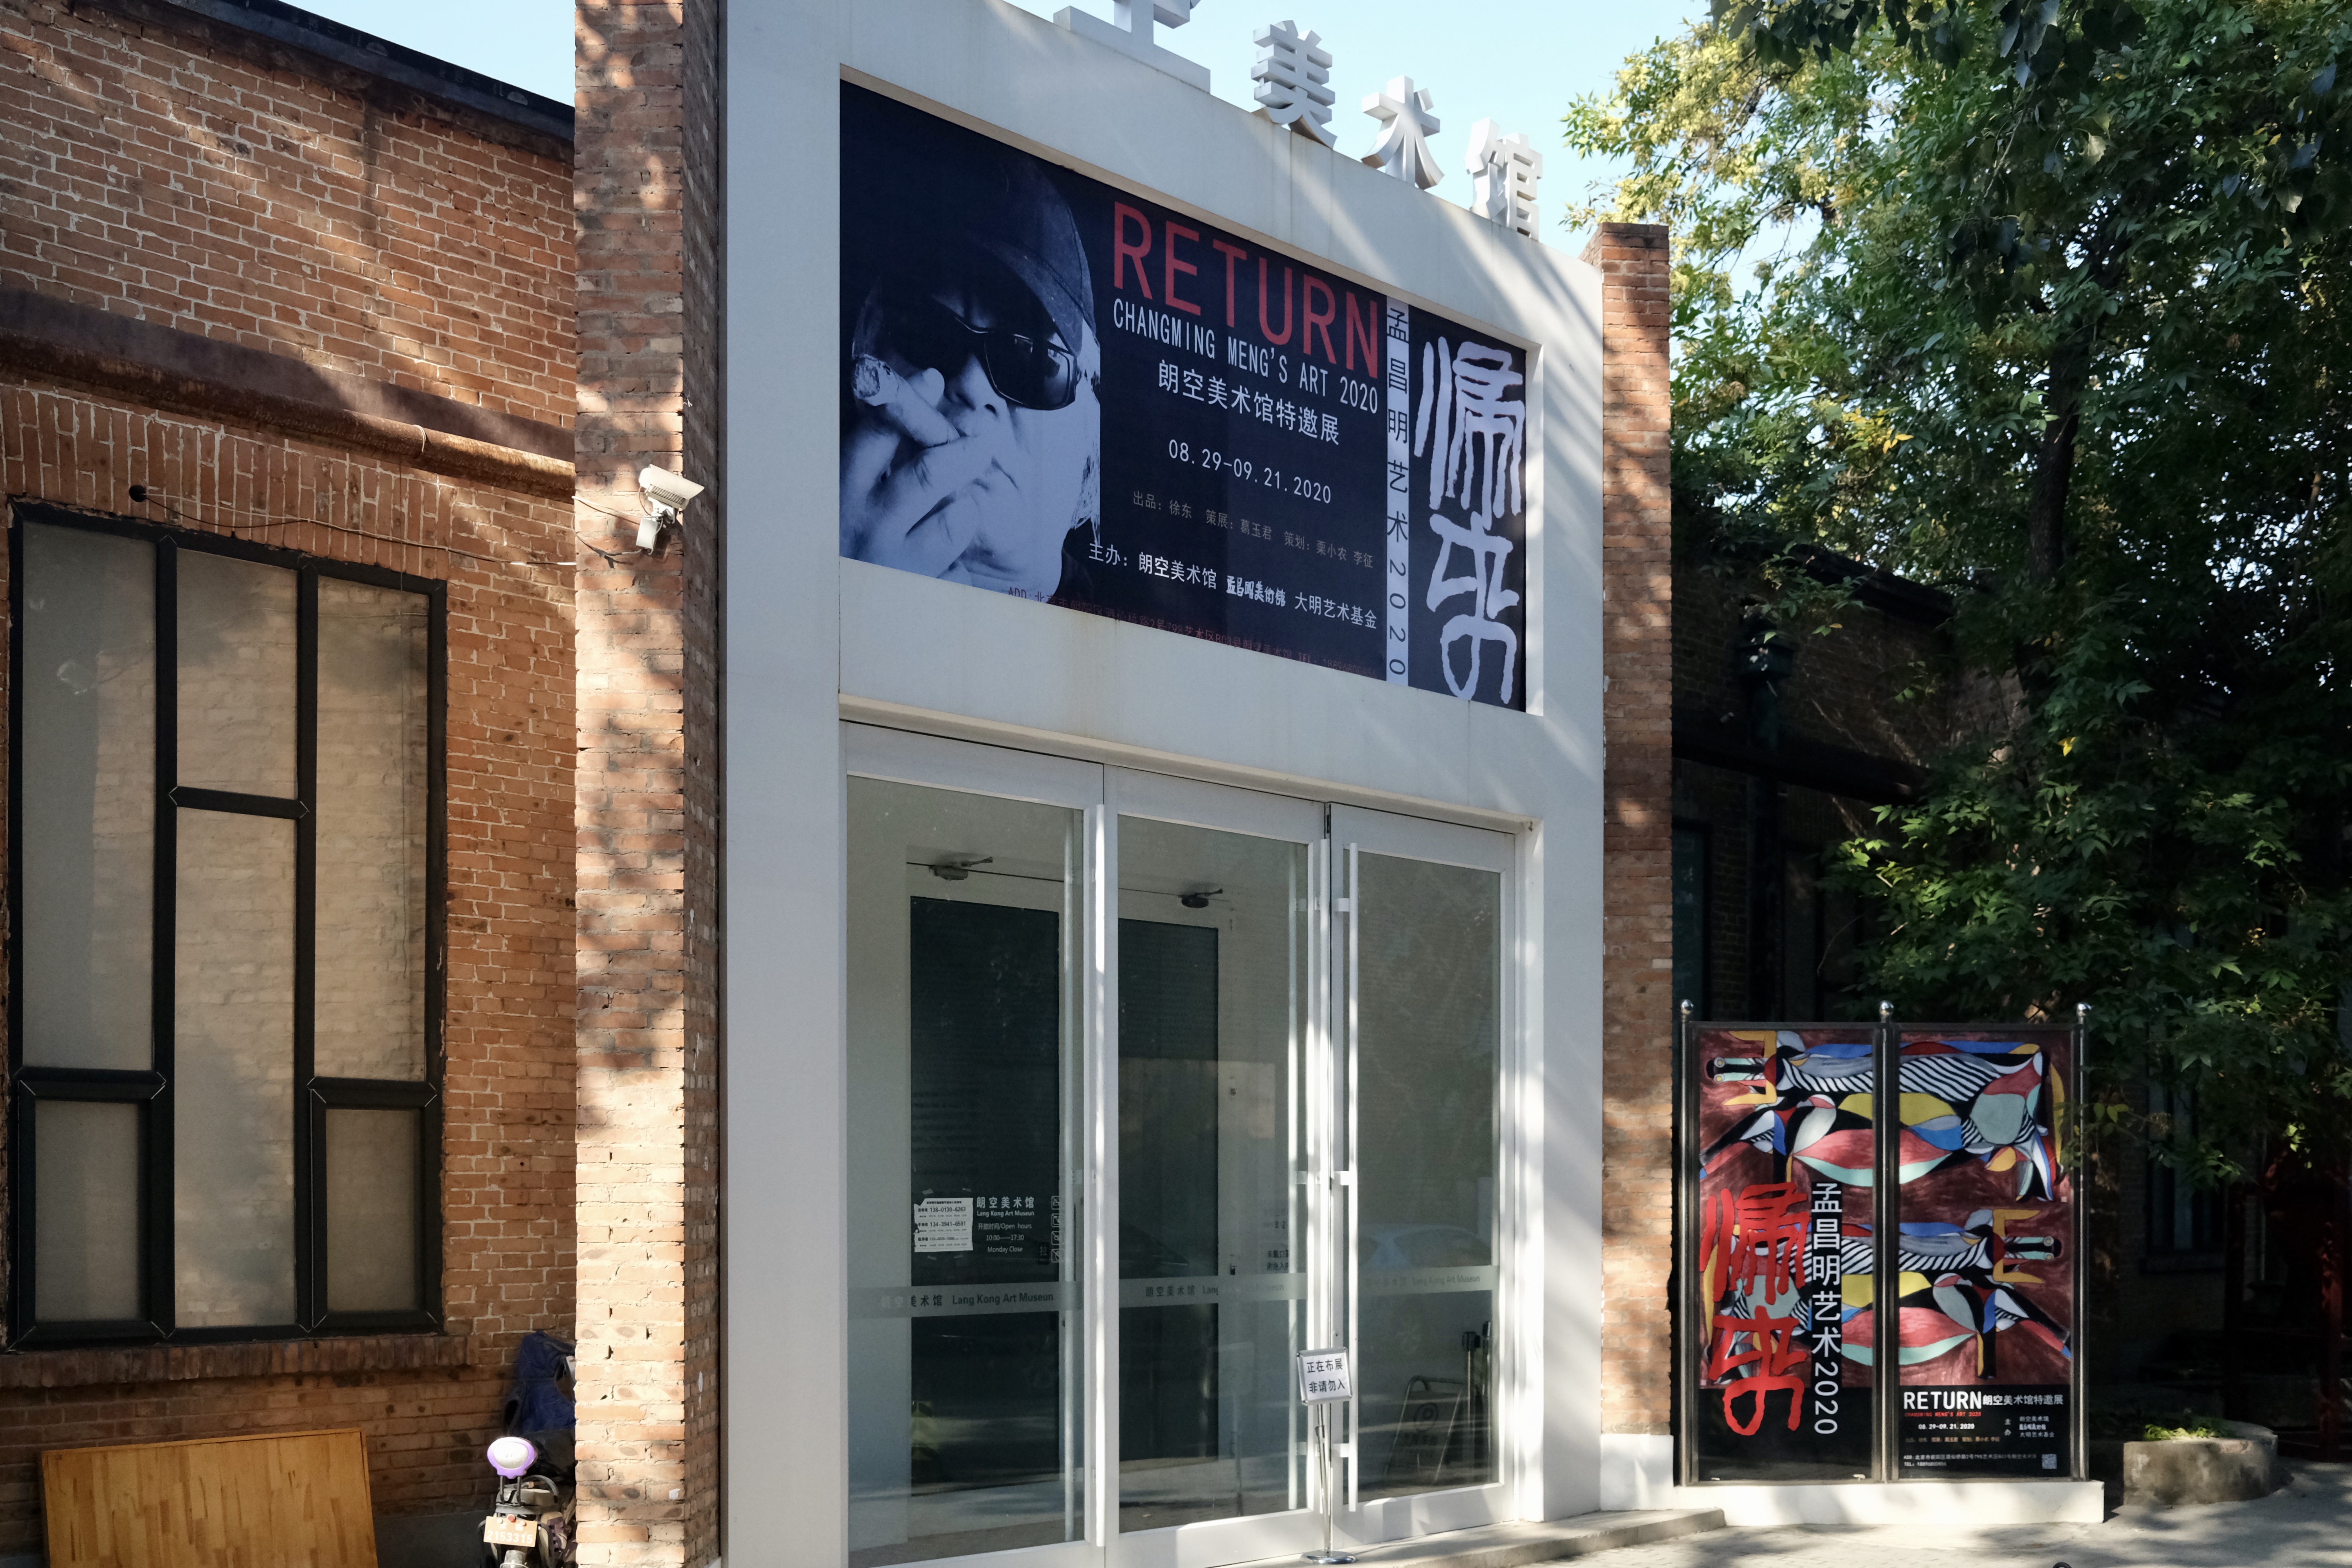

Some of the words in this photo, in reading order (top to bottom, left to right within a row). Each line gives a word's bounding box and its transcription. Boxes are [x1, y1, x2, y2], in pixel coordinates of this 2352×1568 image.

[1114, 202, 1378, 379] RETURN
[1114, 298, 1215, 359] CHANGMING
[1228, 336, 1287, 383] MENG'S
[1300, 362, 1328, 397] ART
[1340, 376, 1378, 414] 2020
[1159, 359, 1339, 445] 朗空美术馆特邀展
[1169, 439, 1331, 504] 08.29-09.21.2020
[1169, 500, 1192, 518] 徐东
[1240, 519, 1272, 540] 葛玉君
[1353, 550, 1373, 568] 李征
[1088, 542, 1127, 566] 主办：
[1139, 551, 1216, 589] 朗空美术馆
[1294, 592, 1377, 629] 大明艺术基金
[976, 1196, 1035, 1208] 朗空美术馆
[952, 1295, 974, 1306] Lang
[977, 1294, 1000, 1305] Kong
[1003, 1293, 1017, 1303] Art
[1307, 1358, 1343, 1373] 正在布展
[1309, 1378, 1345, 1394] 非请勿入
[1904, 1391, 1982, 1410] RETURN
[1983, 1394, 2064, 1405] 朗空美术馆特邀展
[486, 1530, 533, 1544] 2153315
